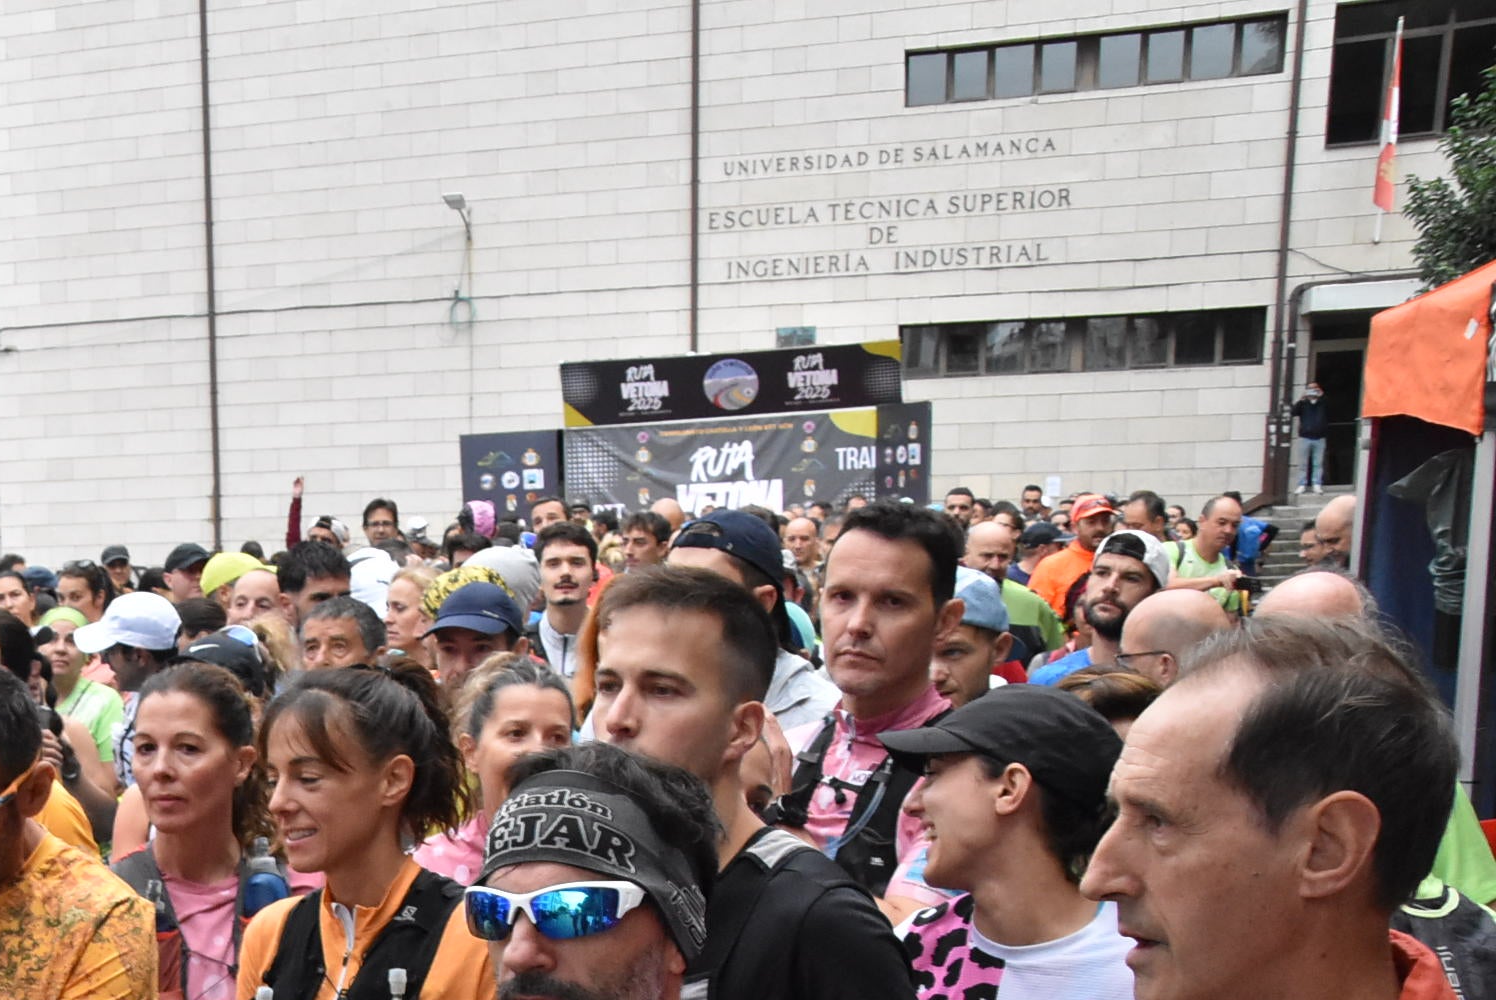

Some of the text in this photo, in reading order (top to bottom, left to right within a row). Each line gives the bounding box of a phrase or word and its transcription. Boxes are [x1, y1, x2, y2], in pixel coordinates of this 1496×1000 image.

[723, 136, 1057, 177] UNIVERSIDAD DE SALAMANCA
[707, 207, 820, 231] ESCUELA
[946, 187, 1073, 215] SUPERIOR
[868, 226, 899, 245] DE
[893, 243, 1050, 270] INDUSTRIAL
[689, 439, 755, 483] RUTA
